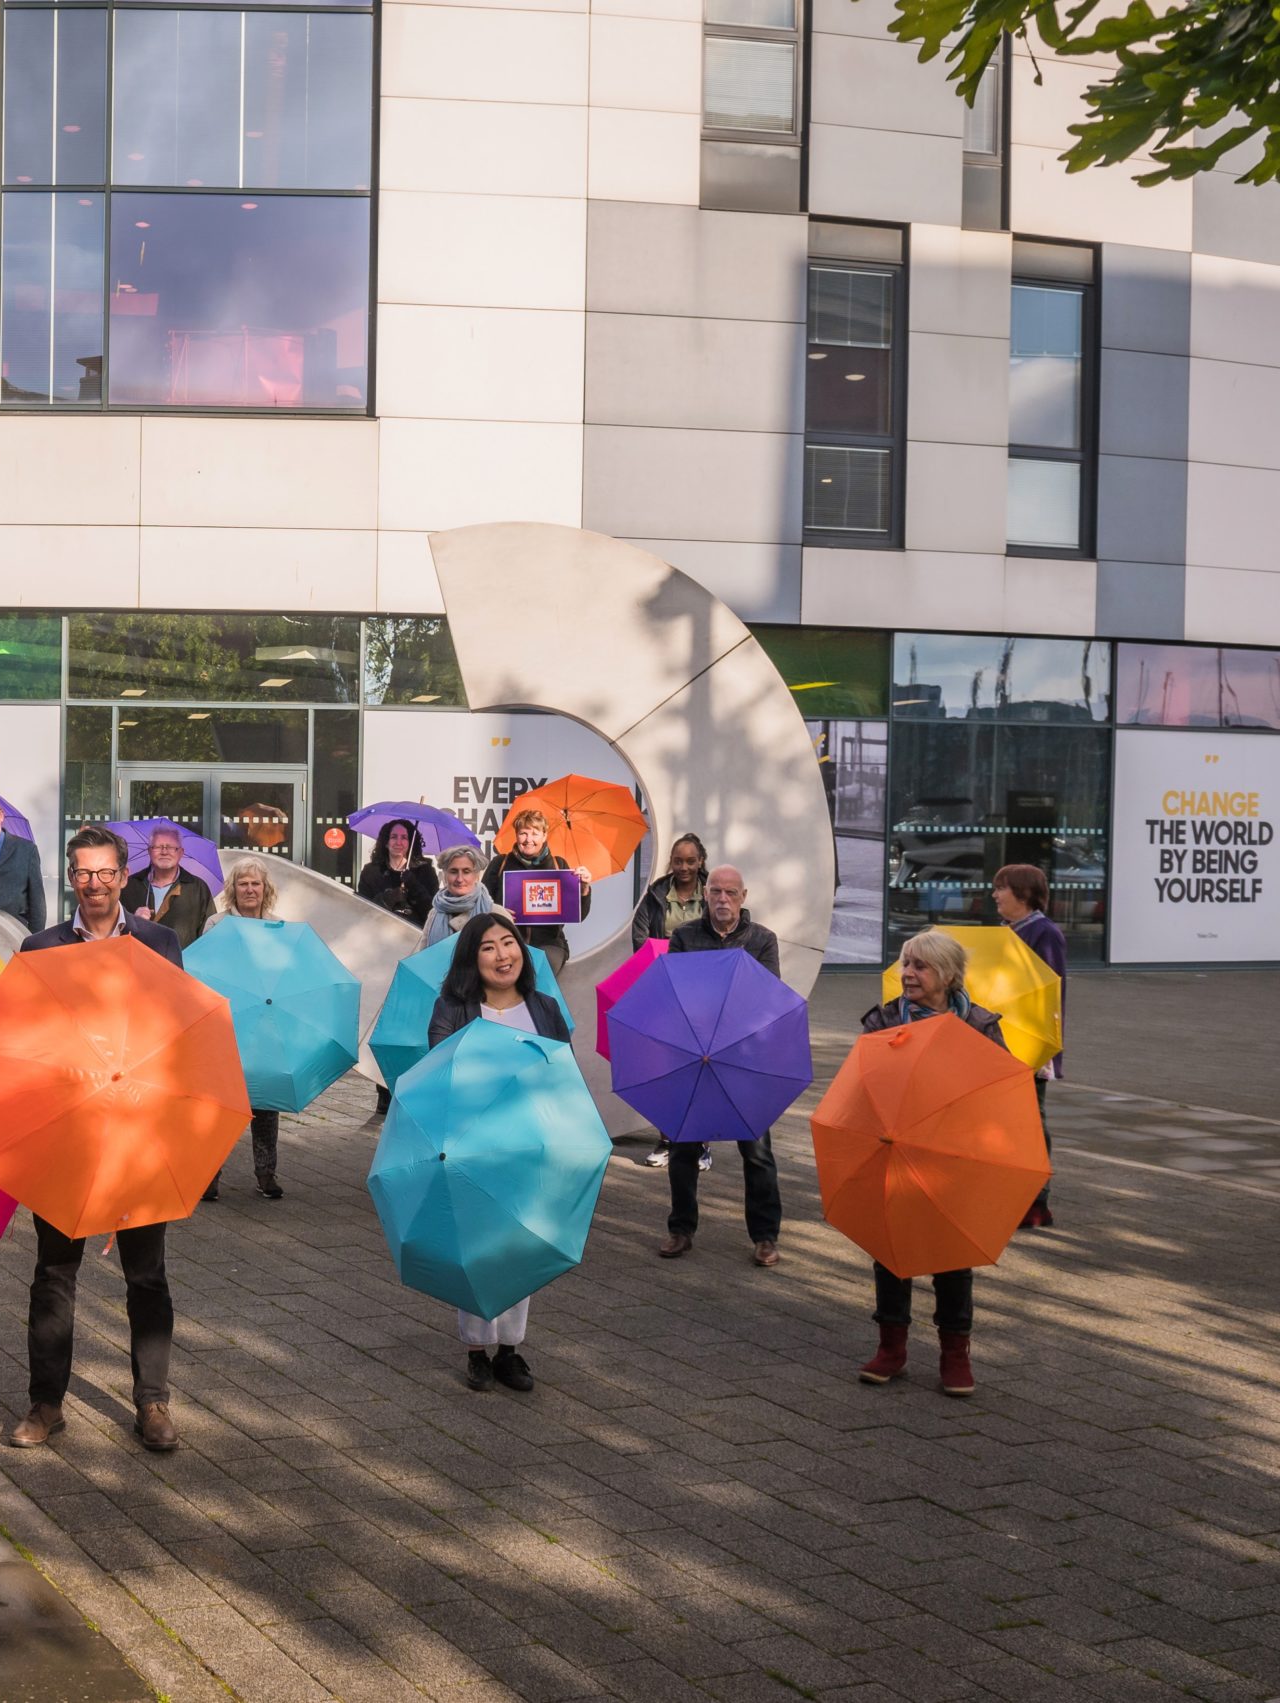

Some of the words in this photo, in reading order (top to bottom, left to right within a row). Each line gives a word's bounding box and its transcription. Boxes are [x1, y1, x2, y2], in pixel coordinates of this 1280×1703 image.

[1161, 790, 1260, 817] CHANGE
[1145, 819, 1187, 845] THE
[1191, 820, 1274, 846] WORLD
[1159, 849, 1188, 874] BY
[1192, 849, 1258, 875] BEING
[1154, 878, 1263, 903] YOURSELF
